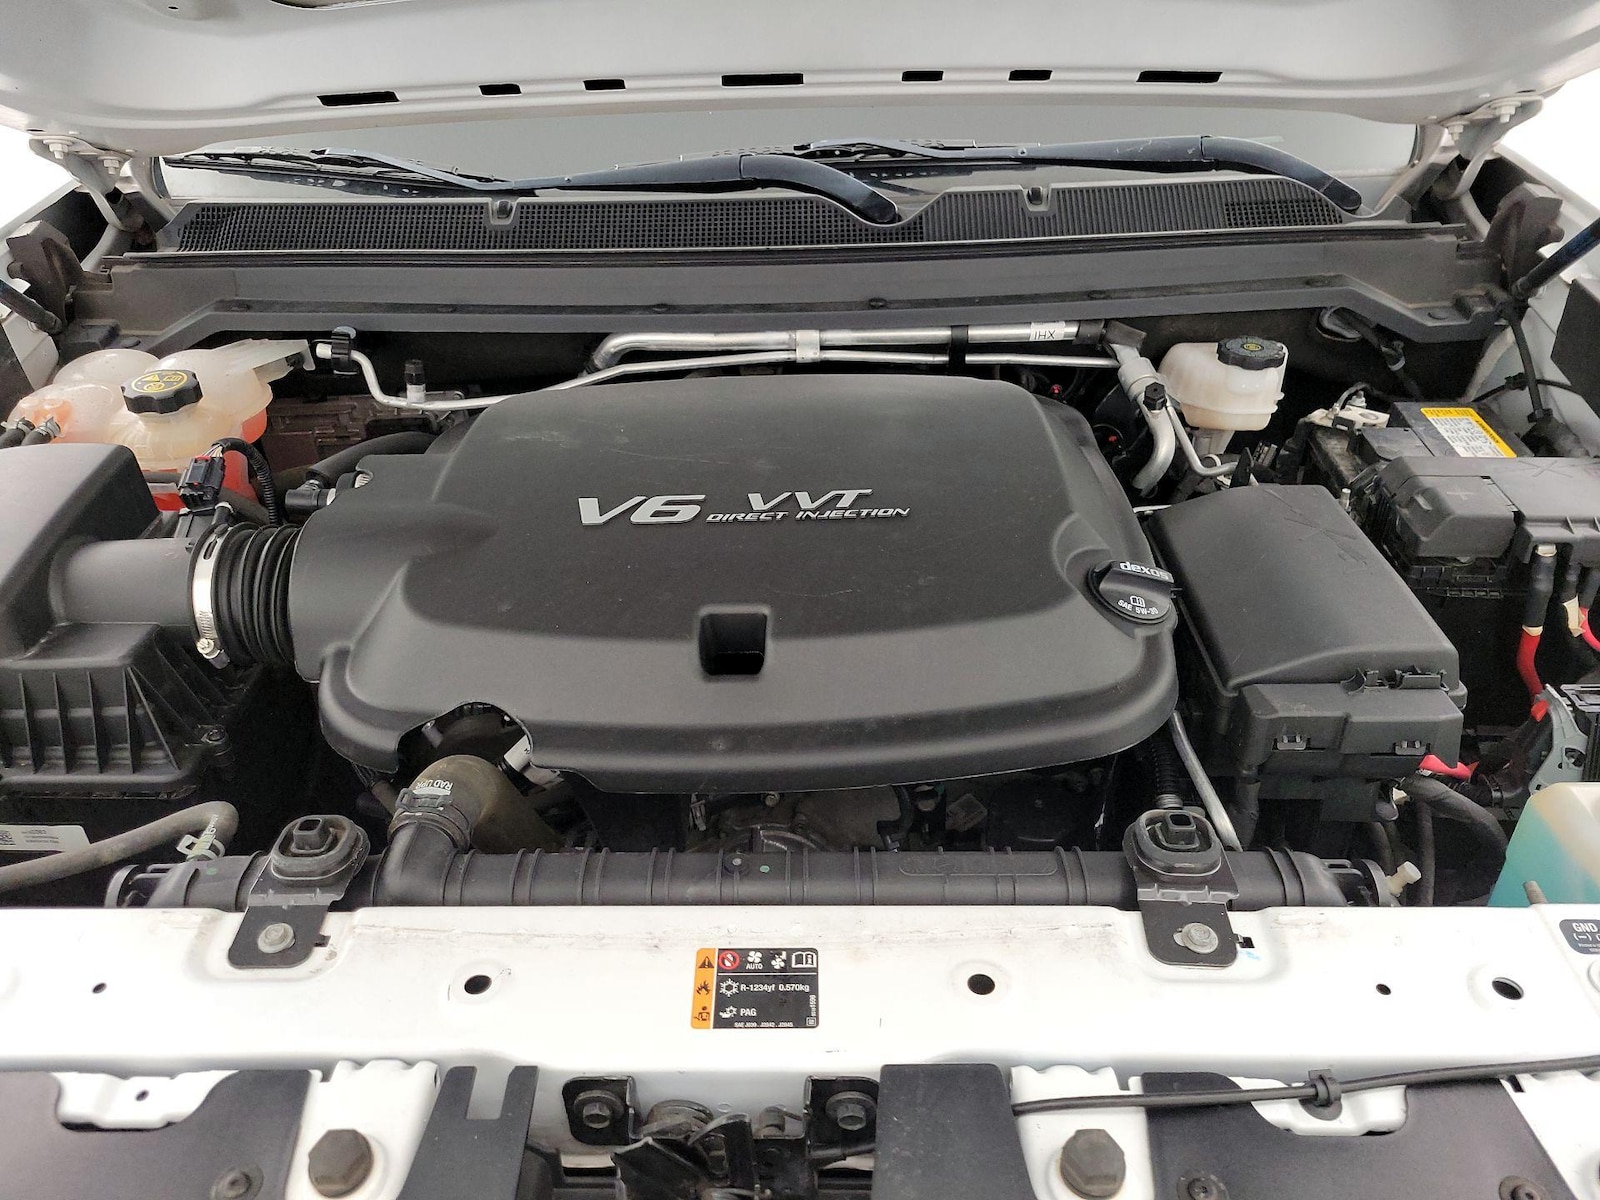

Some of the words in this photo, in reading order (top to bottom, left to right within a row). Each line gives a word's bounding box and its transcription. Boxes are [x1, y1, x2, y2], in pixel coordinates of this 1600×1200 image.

[748, 488, 873, 511] VVT
[578, 494, 706, 526] V6
[705, 511, 789, 523] DIRECT
[795, 507, 911, 521] INJECTION
[1119, 561, 1169, 580] dexos
[1117, 599, 1132, 611] SAE
[433, 779, 453, 791] RAD
[1572, 922, 1598, 933] GND
[740, 983, 776, 993] R-1234yf
[778, 983, 810, 993] 0.570kg
[740, 1008, 757, 1017] PAG
